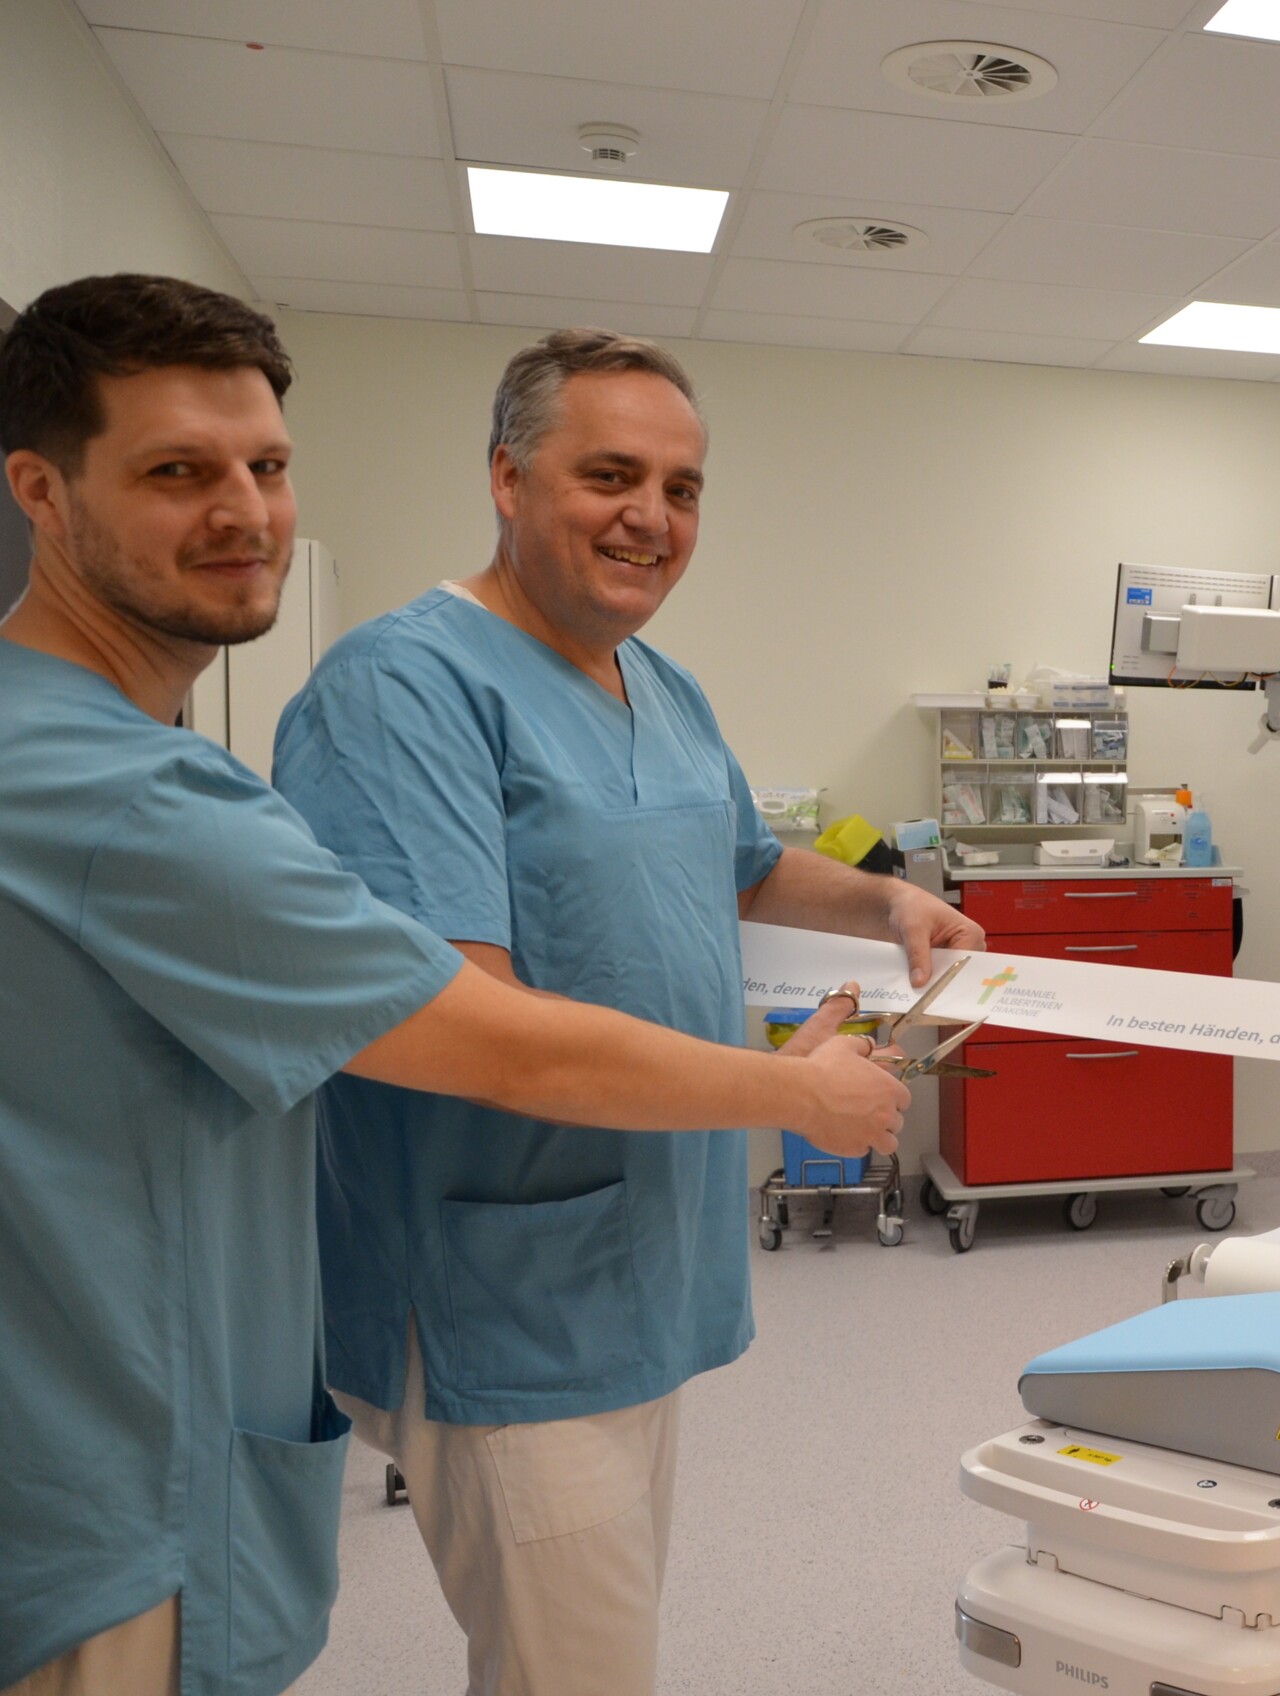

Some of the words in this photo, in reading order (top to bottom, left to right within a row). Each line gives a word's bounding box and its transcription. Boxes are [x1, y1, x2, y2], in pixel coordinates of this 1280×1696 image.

[772, 981, 806, 996] dem
[1003, 986, 1057, 1000] IMMANUEL
[997, 996, 1063, 1011] ALBERTINEN
[990, 1006, 1041, 1018] DIAKONIE
[1106, 1014, 1124, 1027] In
[1127, 1016, 1186, 1034] besten
[1189, 1023, 1264, 1045] Händen,
[1056, 1660, 1109, 1690] PHILIPS
